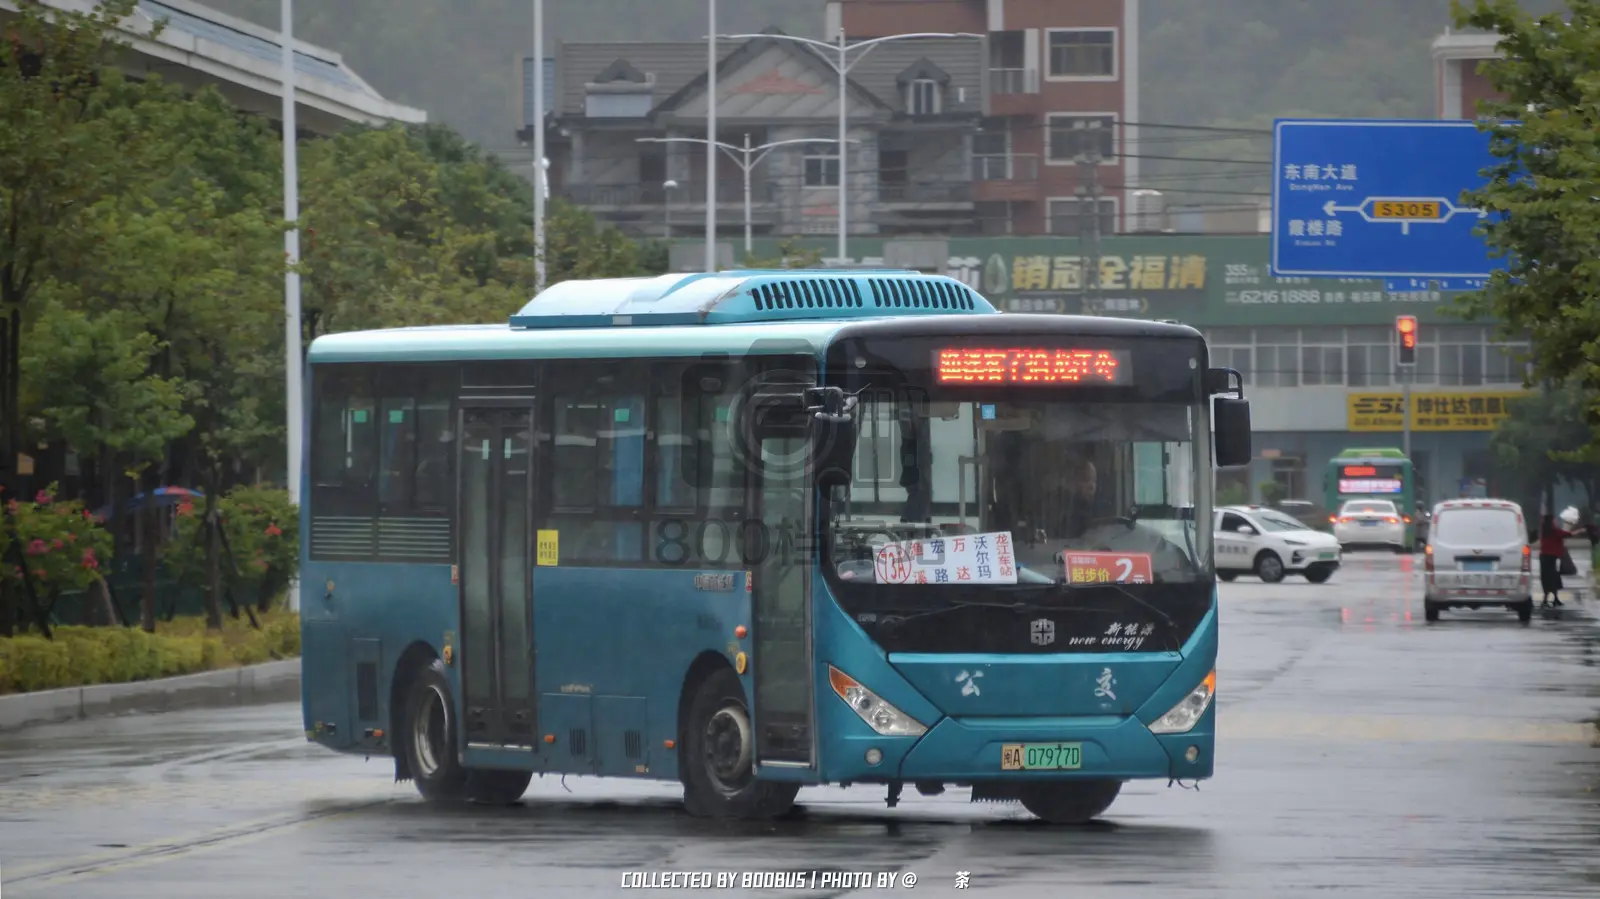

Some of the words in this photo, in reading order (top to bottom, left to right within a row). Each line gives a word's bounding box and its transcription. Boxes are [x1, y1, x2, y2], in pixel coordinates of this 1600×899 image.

[1284, 164, 1358, 181] 东南大道
[1381, 203, 1434, 217] S305
[952, 538, 971, 581] 万达
[973, 536, 992, 579] 沃尔玛
[1072, 568, 1110, 583] 起步价
[1069, 636, 1097, 646] new
[1101, 636, 1144, 651] energy
